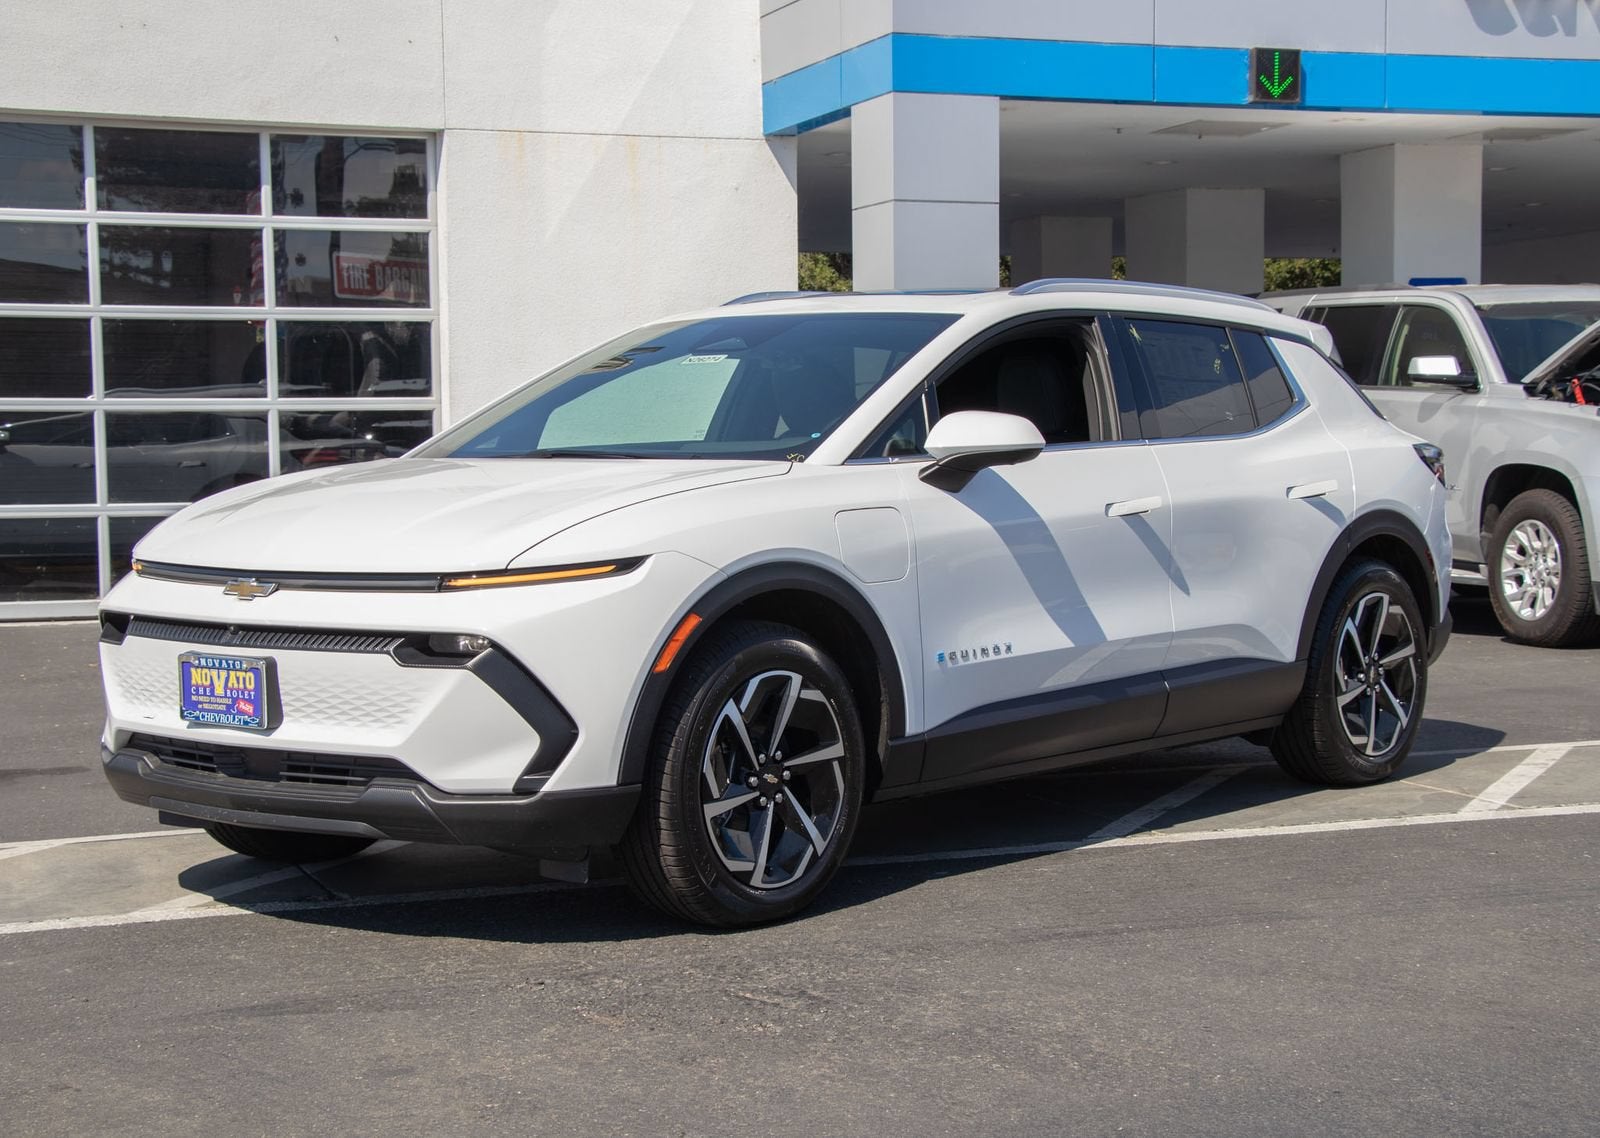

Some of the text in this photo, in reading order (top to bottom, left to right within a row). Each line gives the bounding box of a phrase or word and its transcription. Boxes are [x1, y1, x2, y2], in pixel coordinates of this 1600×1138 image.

[342, 262, 370, 290] TIRE
[936, 641, 1013, 662] EQUINOX
[199, 657, 241, 669] NOVATO
[191, 667, 255, 696] NOVATO
[199, 711, 245, 725] CHEVROLET
